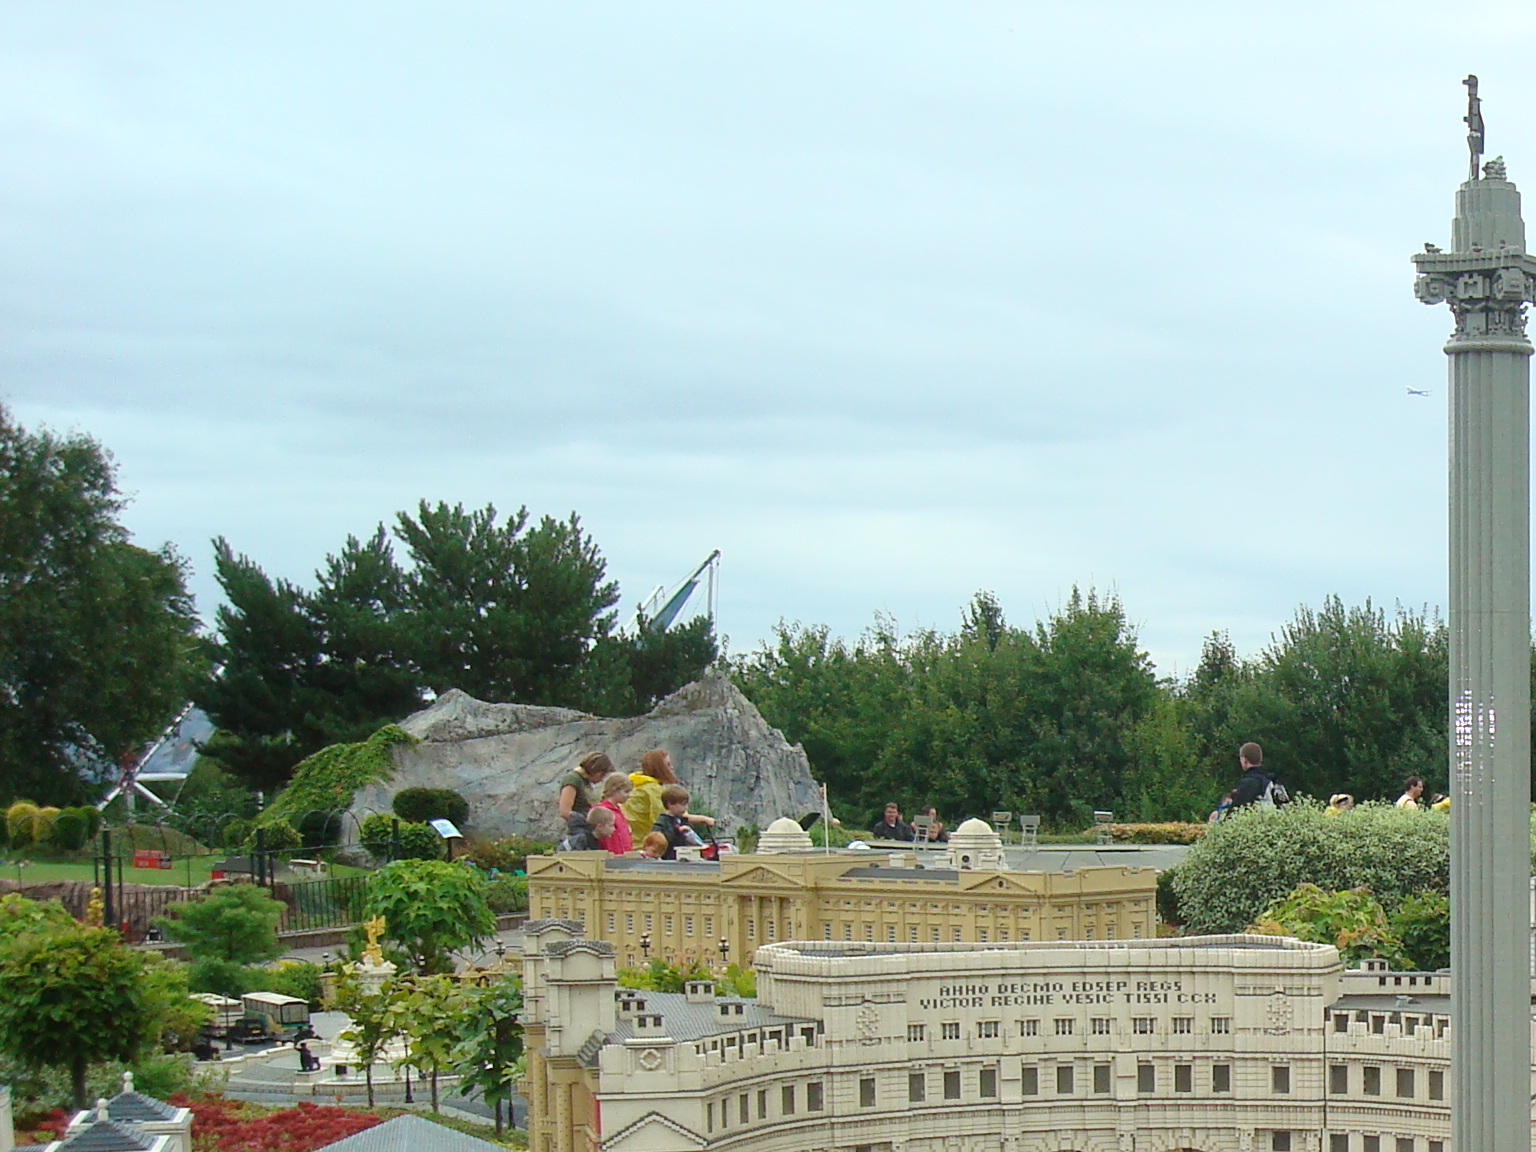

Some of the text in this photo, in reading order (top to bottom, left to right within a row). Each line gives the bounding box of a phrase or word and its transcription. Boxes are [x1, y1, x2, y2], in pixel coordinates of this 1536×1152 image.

[1072, 981, 1128, 992] EDSEP
[1136, 980, 1182, 992] REGS
[1123, 993, 1168, 1004] TISSI
